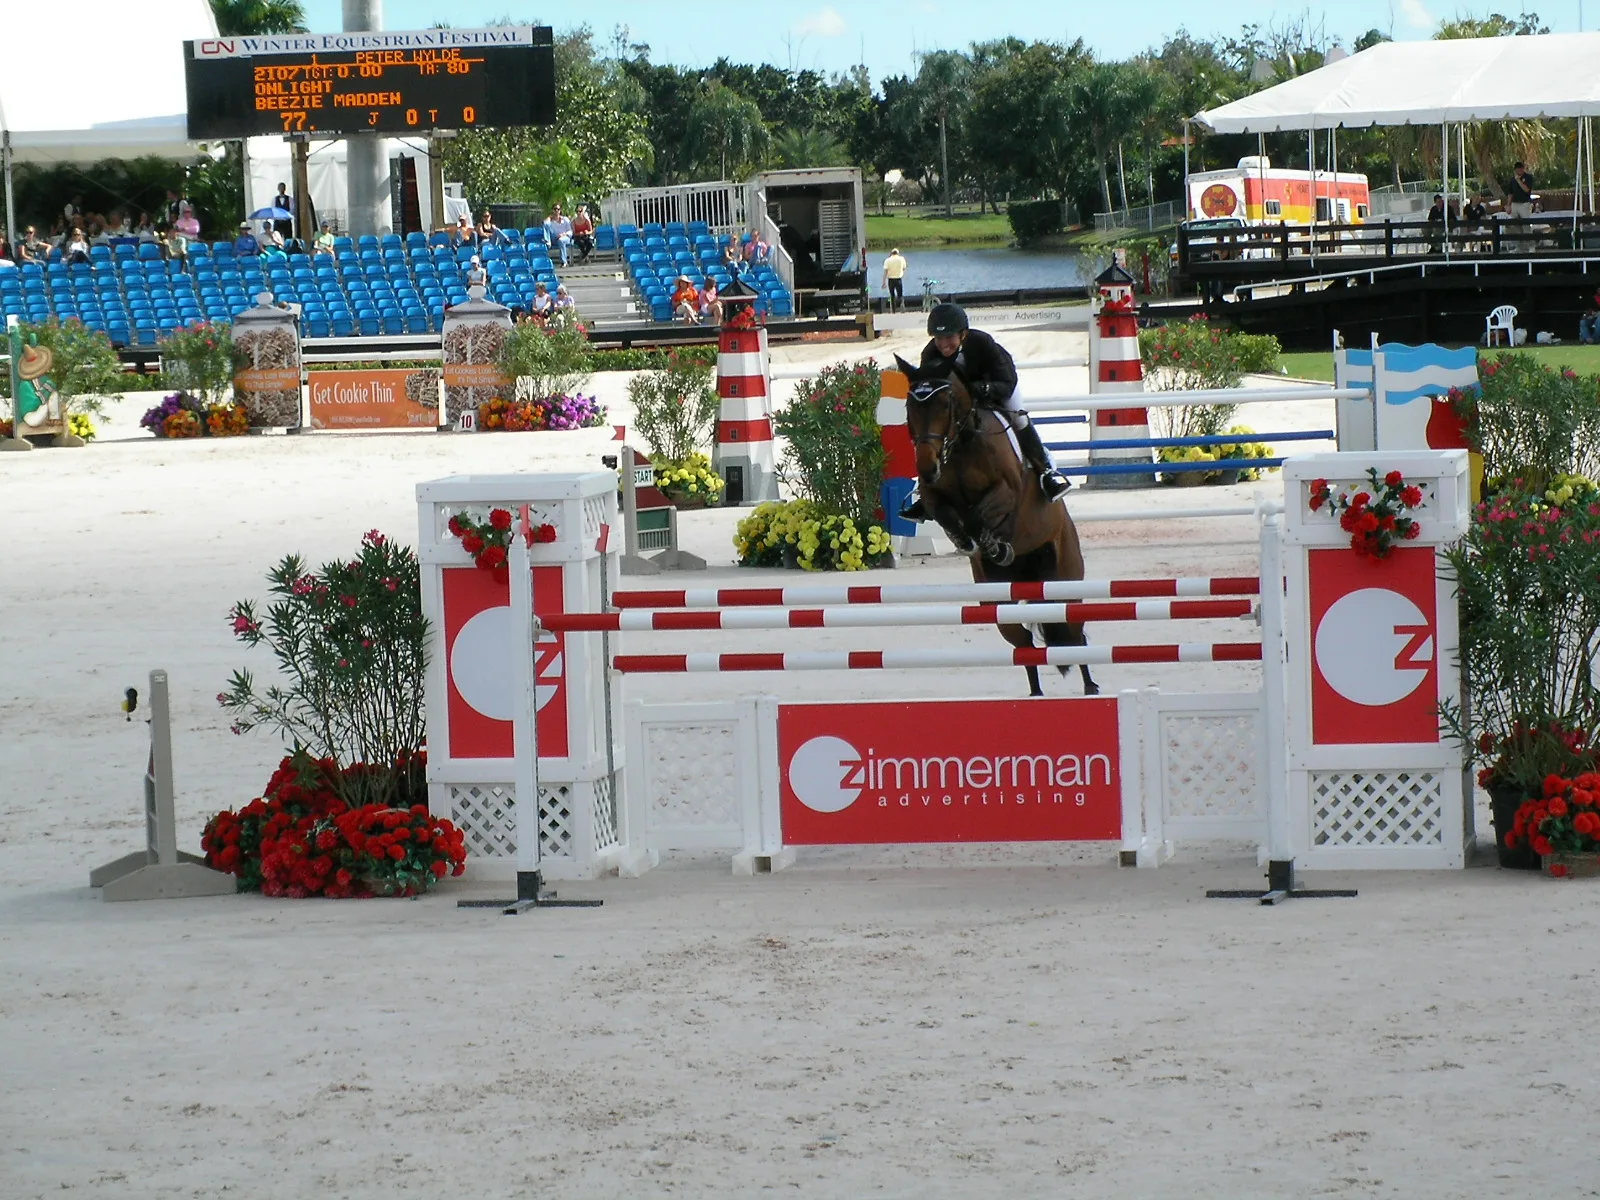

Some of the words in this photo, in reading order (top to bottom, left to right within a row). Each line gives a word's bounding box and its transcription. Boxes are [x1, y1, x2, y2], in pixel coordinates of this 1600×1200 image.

[201, 40, 235, 54] CN
[241, 38, 316, 51] WINTER
[322, 33, 435, 50] EQUESTRIAN
[439, 32, 522, 46] FESTIVAL
[355, 51, 404, 64] PETER
[413, 48, 461, 62] WYLDE
[254, 67, 299, 81] 2107
[447, 61, 469, 74] 80
[255, 80, 333, 95] ONLIGHT
[255, 94, 323, 110] BEEZIE
[334, 92, 401, 107] MADDEN
[368, 111, 379, 125] J
[428, 109, 438, 123] T
[1014, 310, 1061, 320] Advertising
[313, 382, 332, 404] Get
[334, 381, 368, 404] Cookie
[460, 415, 472, 429] 10
[634, 468, 652, 483] START
[878, 790, 1085, 807] advertising
